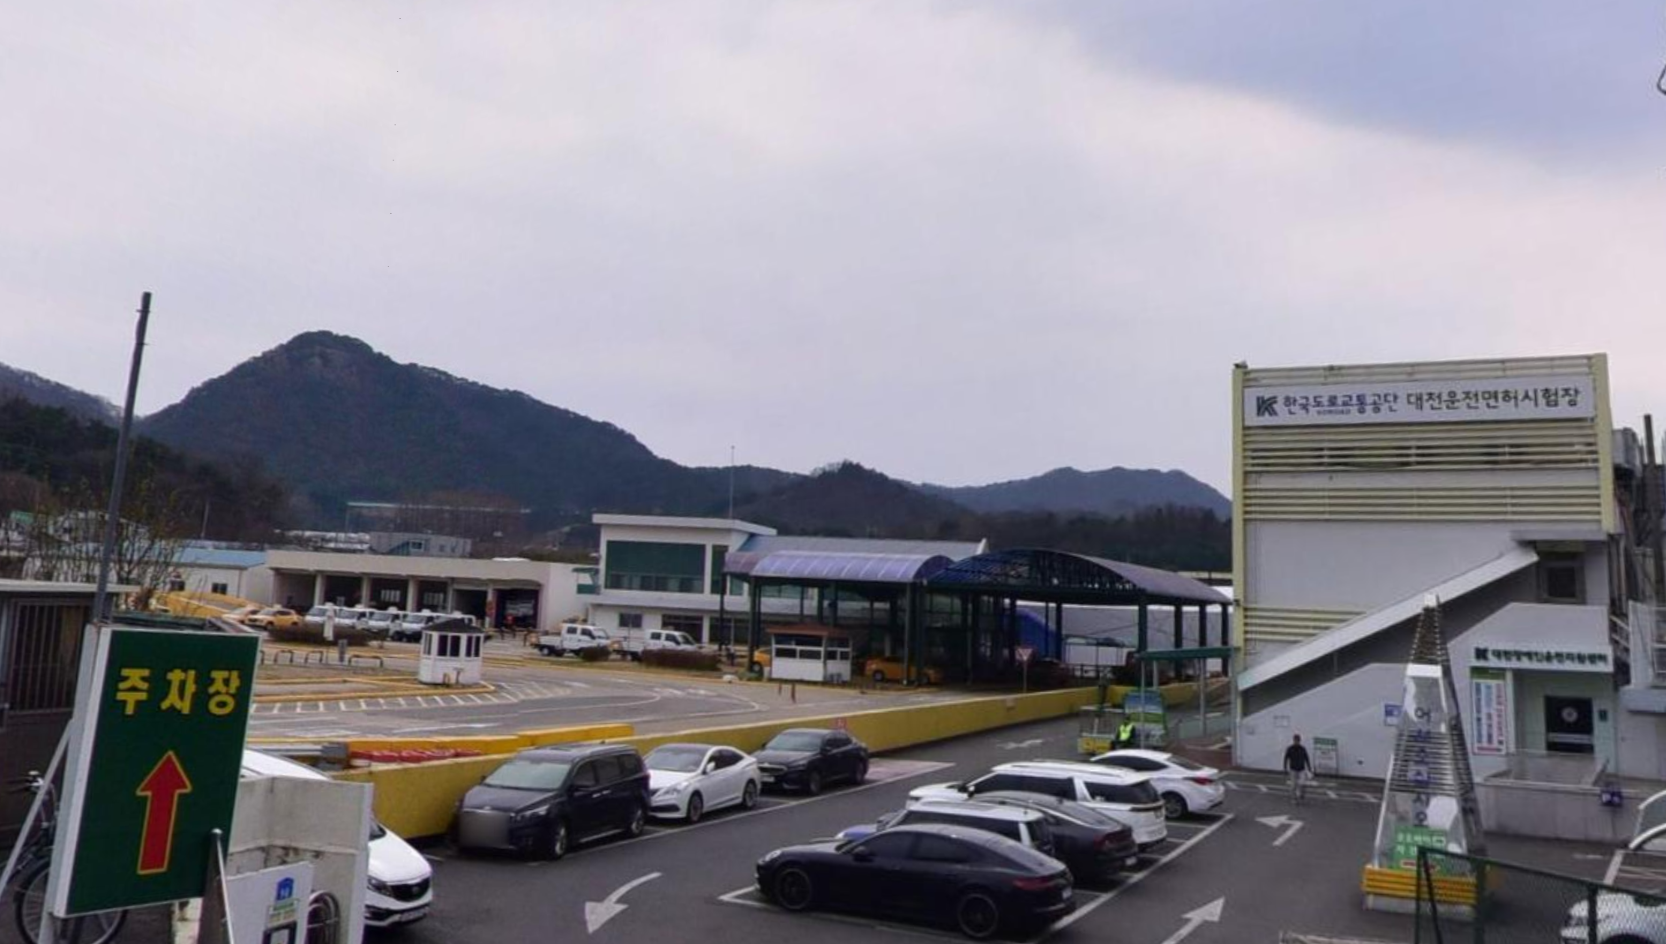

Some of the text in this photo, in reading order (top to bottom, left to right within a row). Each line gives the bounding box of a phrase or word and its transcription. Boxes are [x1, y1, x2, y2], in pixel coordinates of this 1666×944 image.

[1283, 386, 1581, 415] 한국도로교통공단 대전운전면허시험장
[116, 667, 241, 716] 주차장
